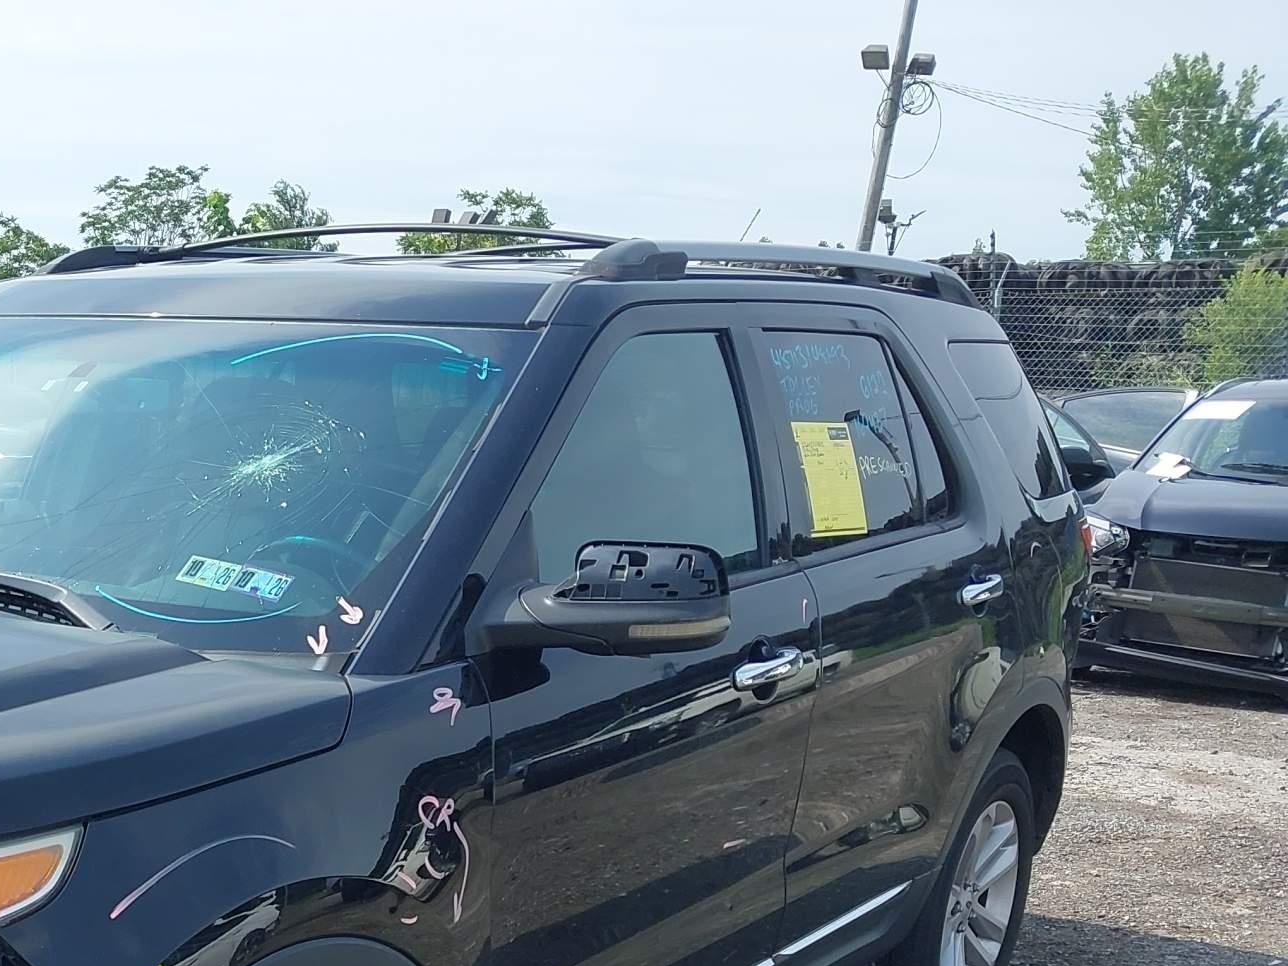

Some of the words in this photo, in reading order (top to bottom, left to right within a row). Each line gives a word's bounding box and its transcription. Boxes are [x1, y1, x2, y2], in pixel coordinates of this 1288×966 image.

[185, 559, 205, 577] 10
[216, 567, 236, 585] 26
[235, 570, 256, 588] 10
[268, 578, 288, 596] 26
